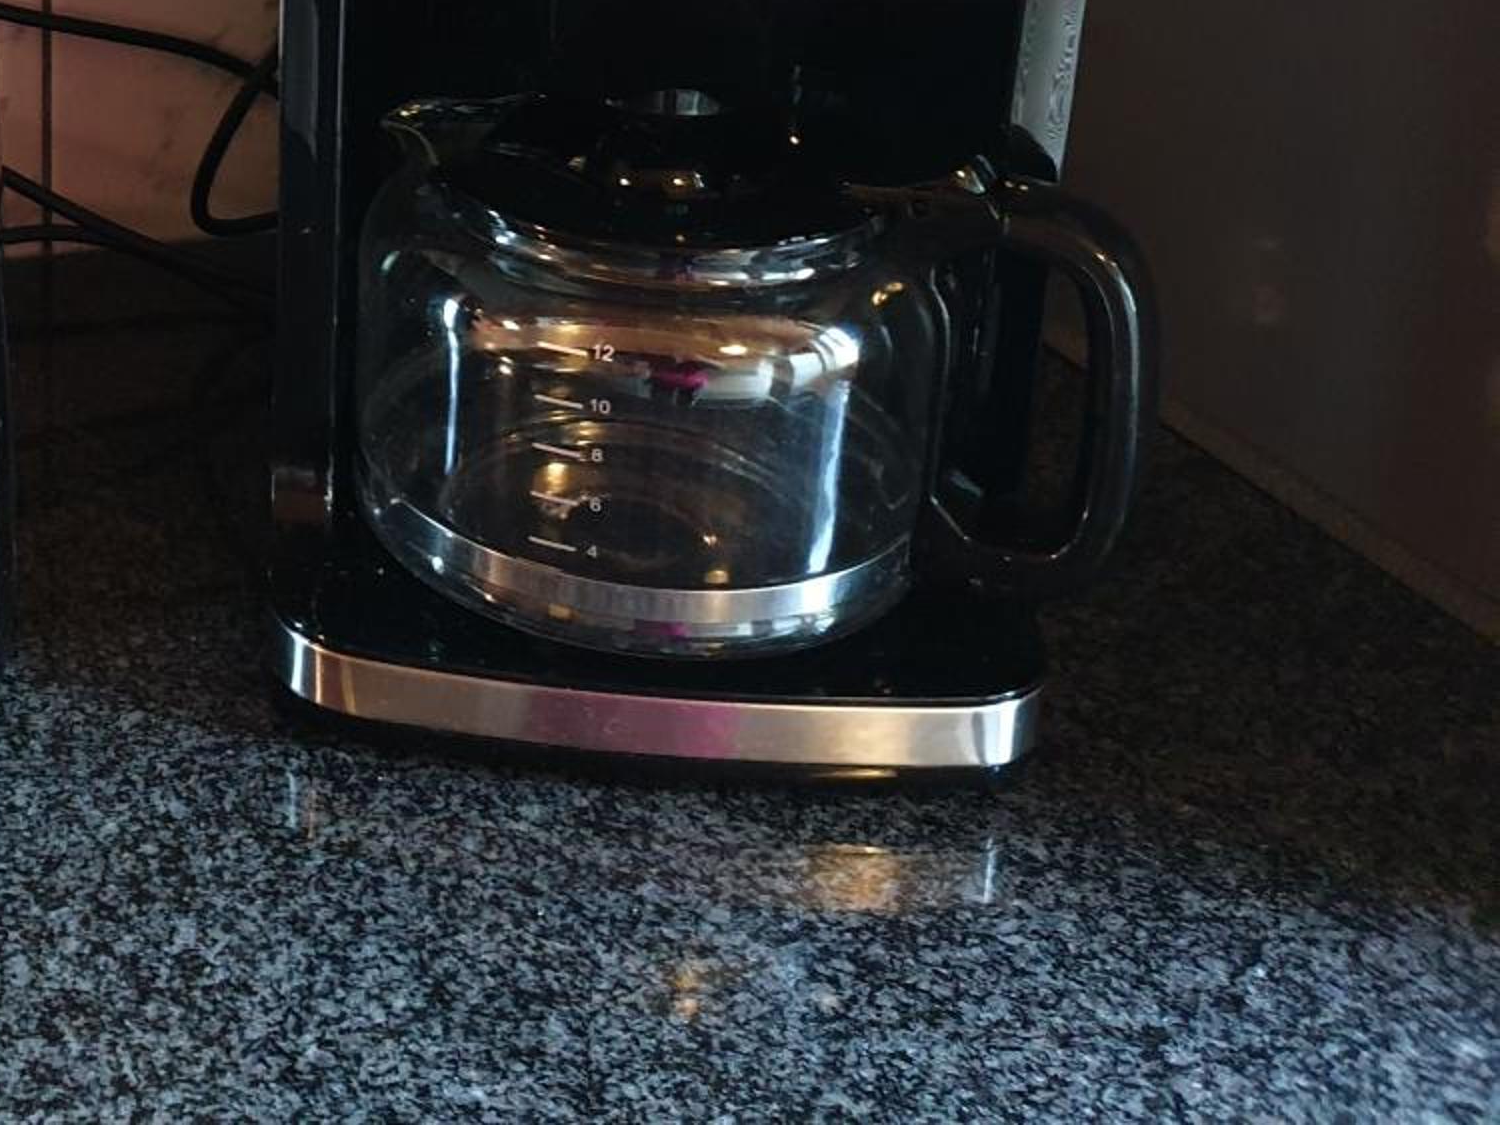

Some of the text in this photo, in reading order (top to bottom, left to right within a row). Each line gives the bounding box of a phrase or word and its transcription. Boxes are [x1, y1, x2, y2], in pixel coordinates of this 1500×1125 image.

[593, 345, 615, 362] 12
[590, 399, 611, 415] 10
[592, 449, 603, 462] 8
[587, 546, 597, 558] 4
